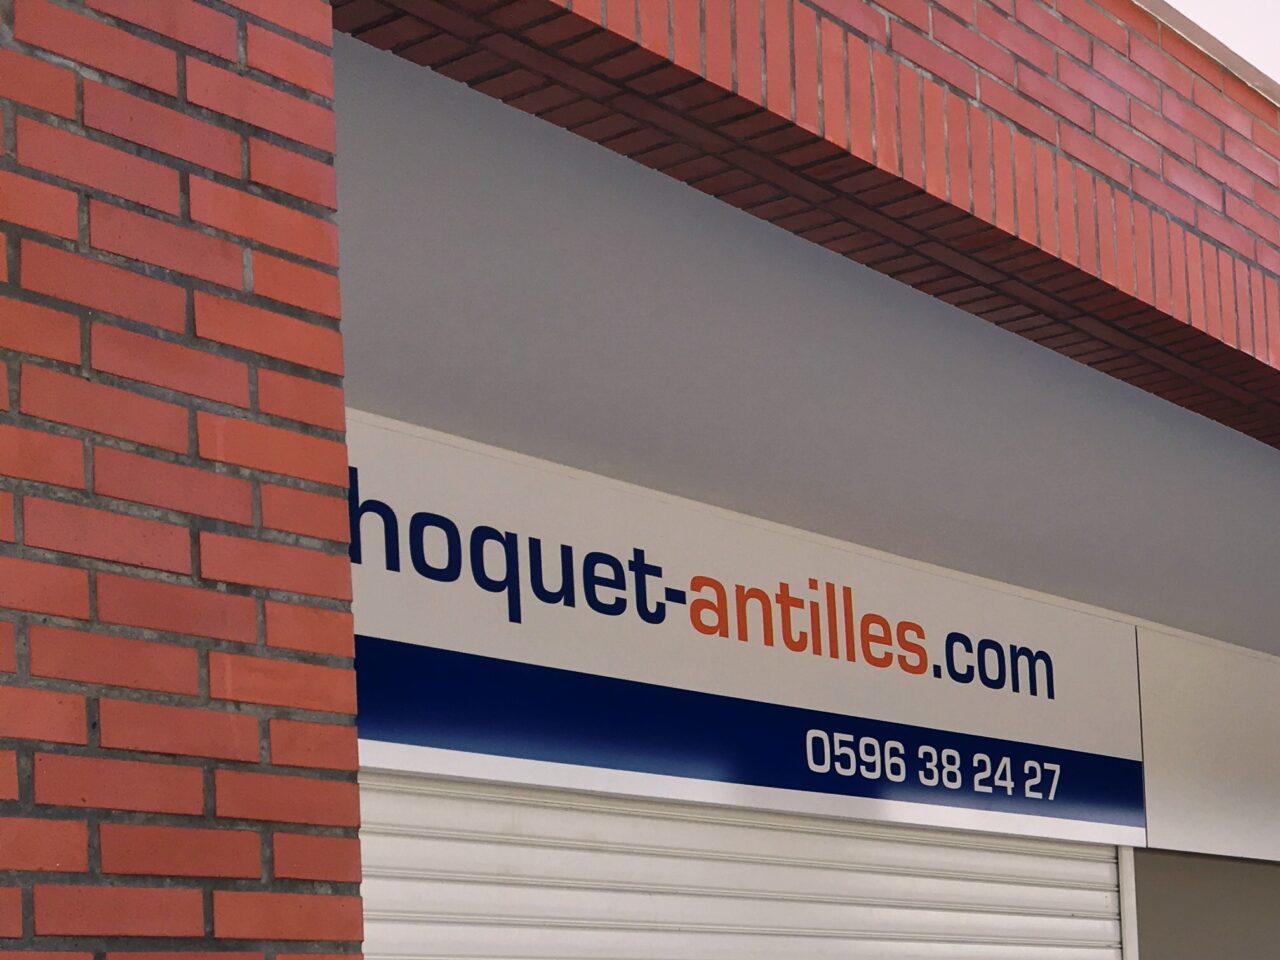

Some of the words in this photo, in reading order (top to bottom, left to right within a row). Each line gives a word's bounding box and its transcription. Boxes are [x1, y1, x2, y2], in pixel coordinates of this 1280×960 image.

[805, 729, 906, 783] 0596
[917, 745, 962, 790] 38
[972, 753, 1015, 796] 24
[1023, 761, 1061, 801] 27
